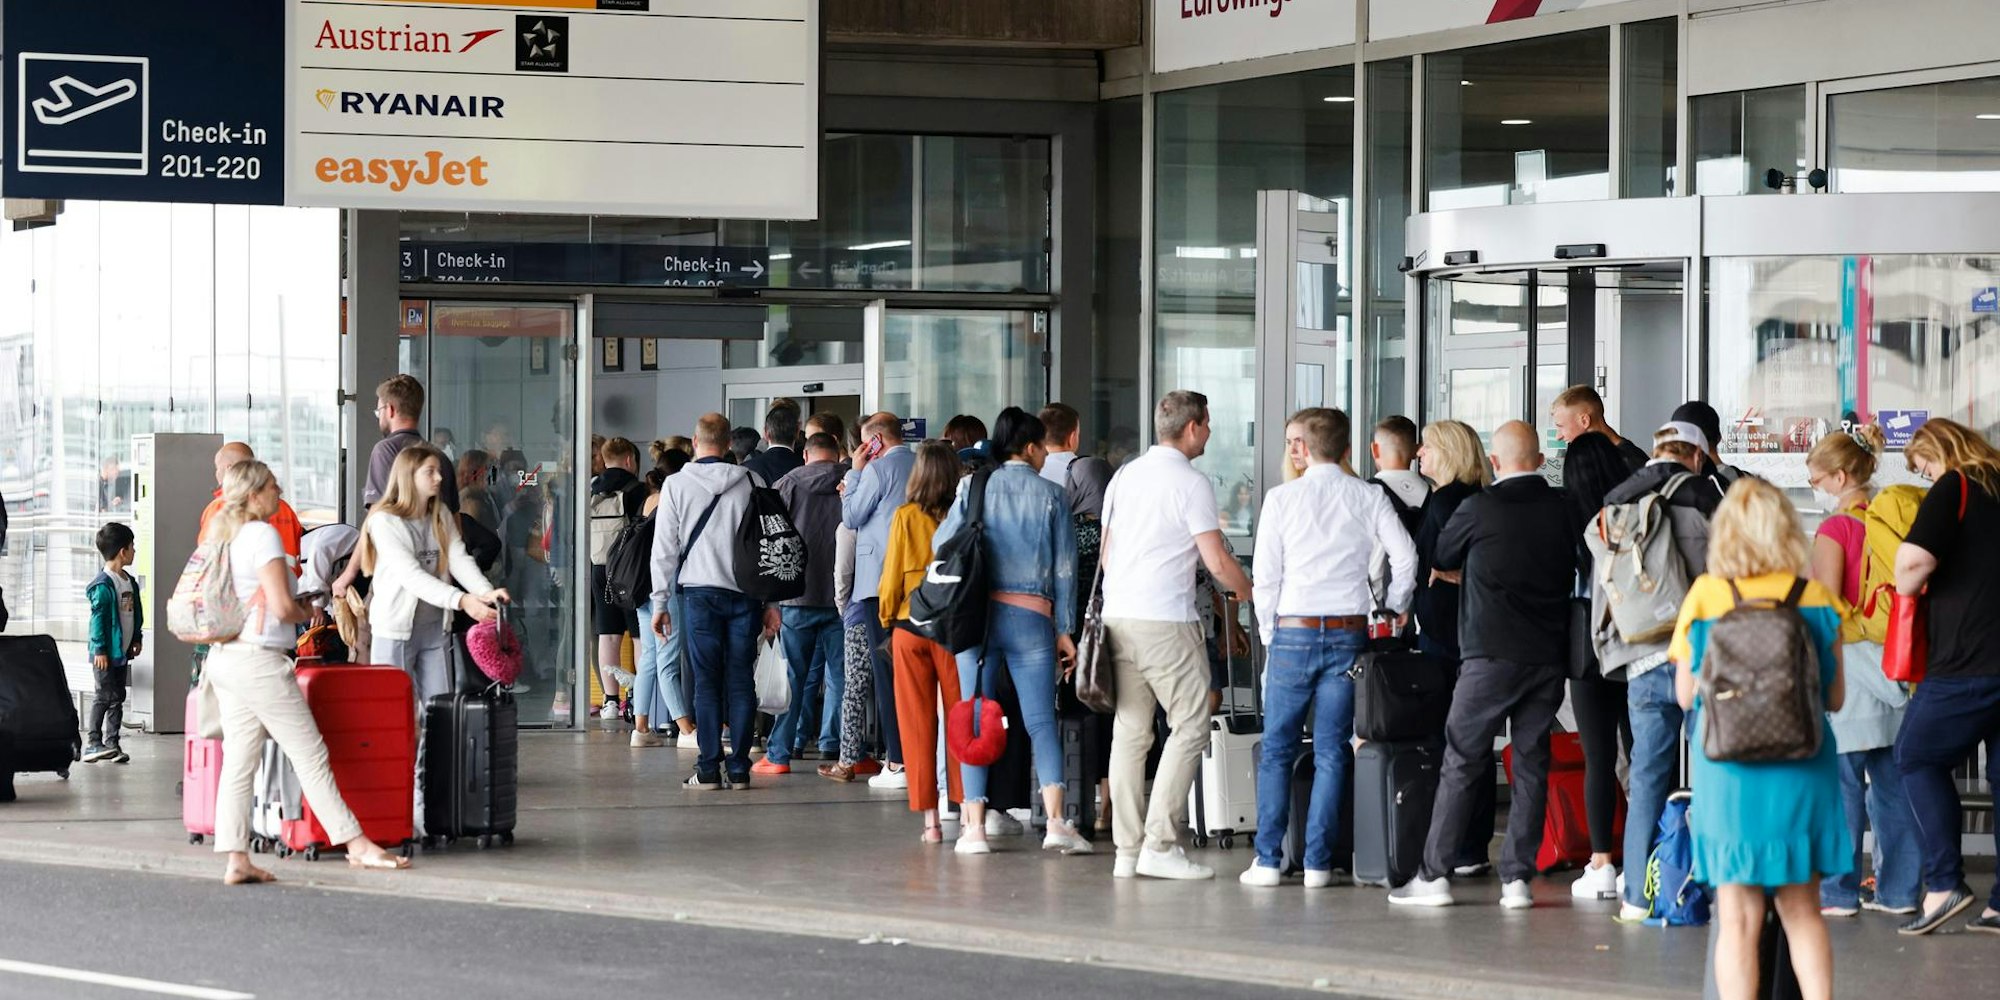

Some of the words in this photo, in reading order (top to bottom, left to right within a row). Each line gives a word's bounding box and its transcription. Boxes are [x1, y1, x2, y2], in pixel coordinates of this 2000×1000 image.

[316, 20, 451, 53] Austrian
[341, 91, 505, 119] RYANAIR
[162, 120, 267, 145] Check-in
[161, 155, 261, 179] 201-220
[315, 151, 488, 192] easyJet
[437, 252, 506, 268] Check-in
[664, 256, 731, 273] Check-in
